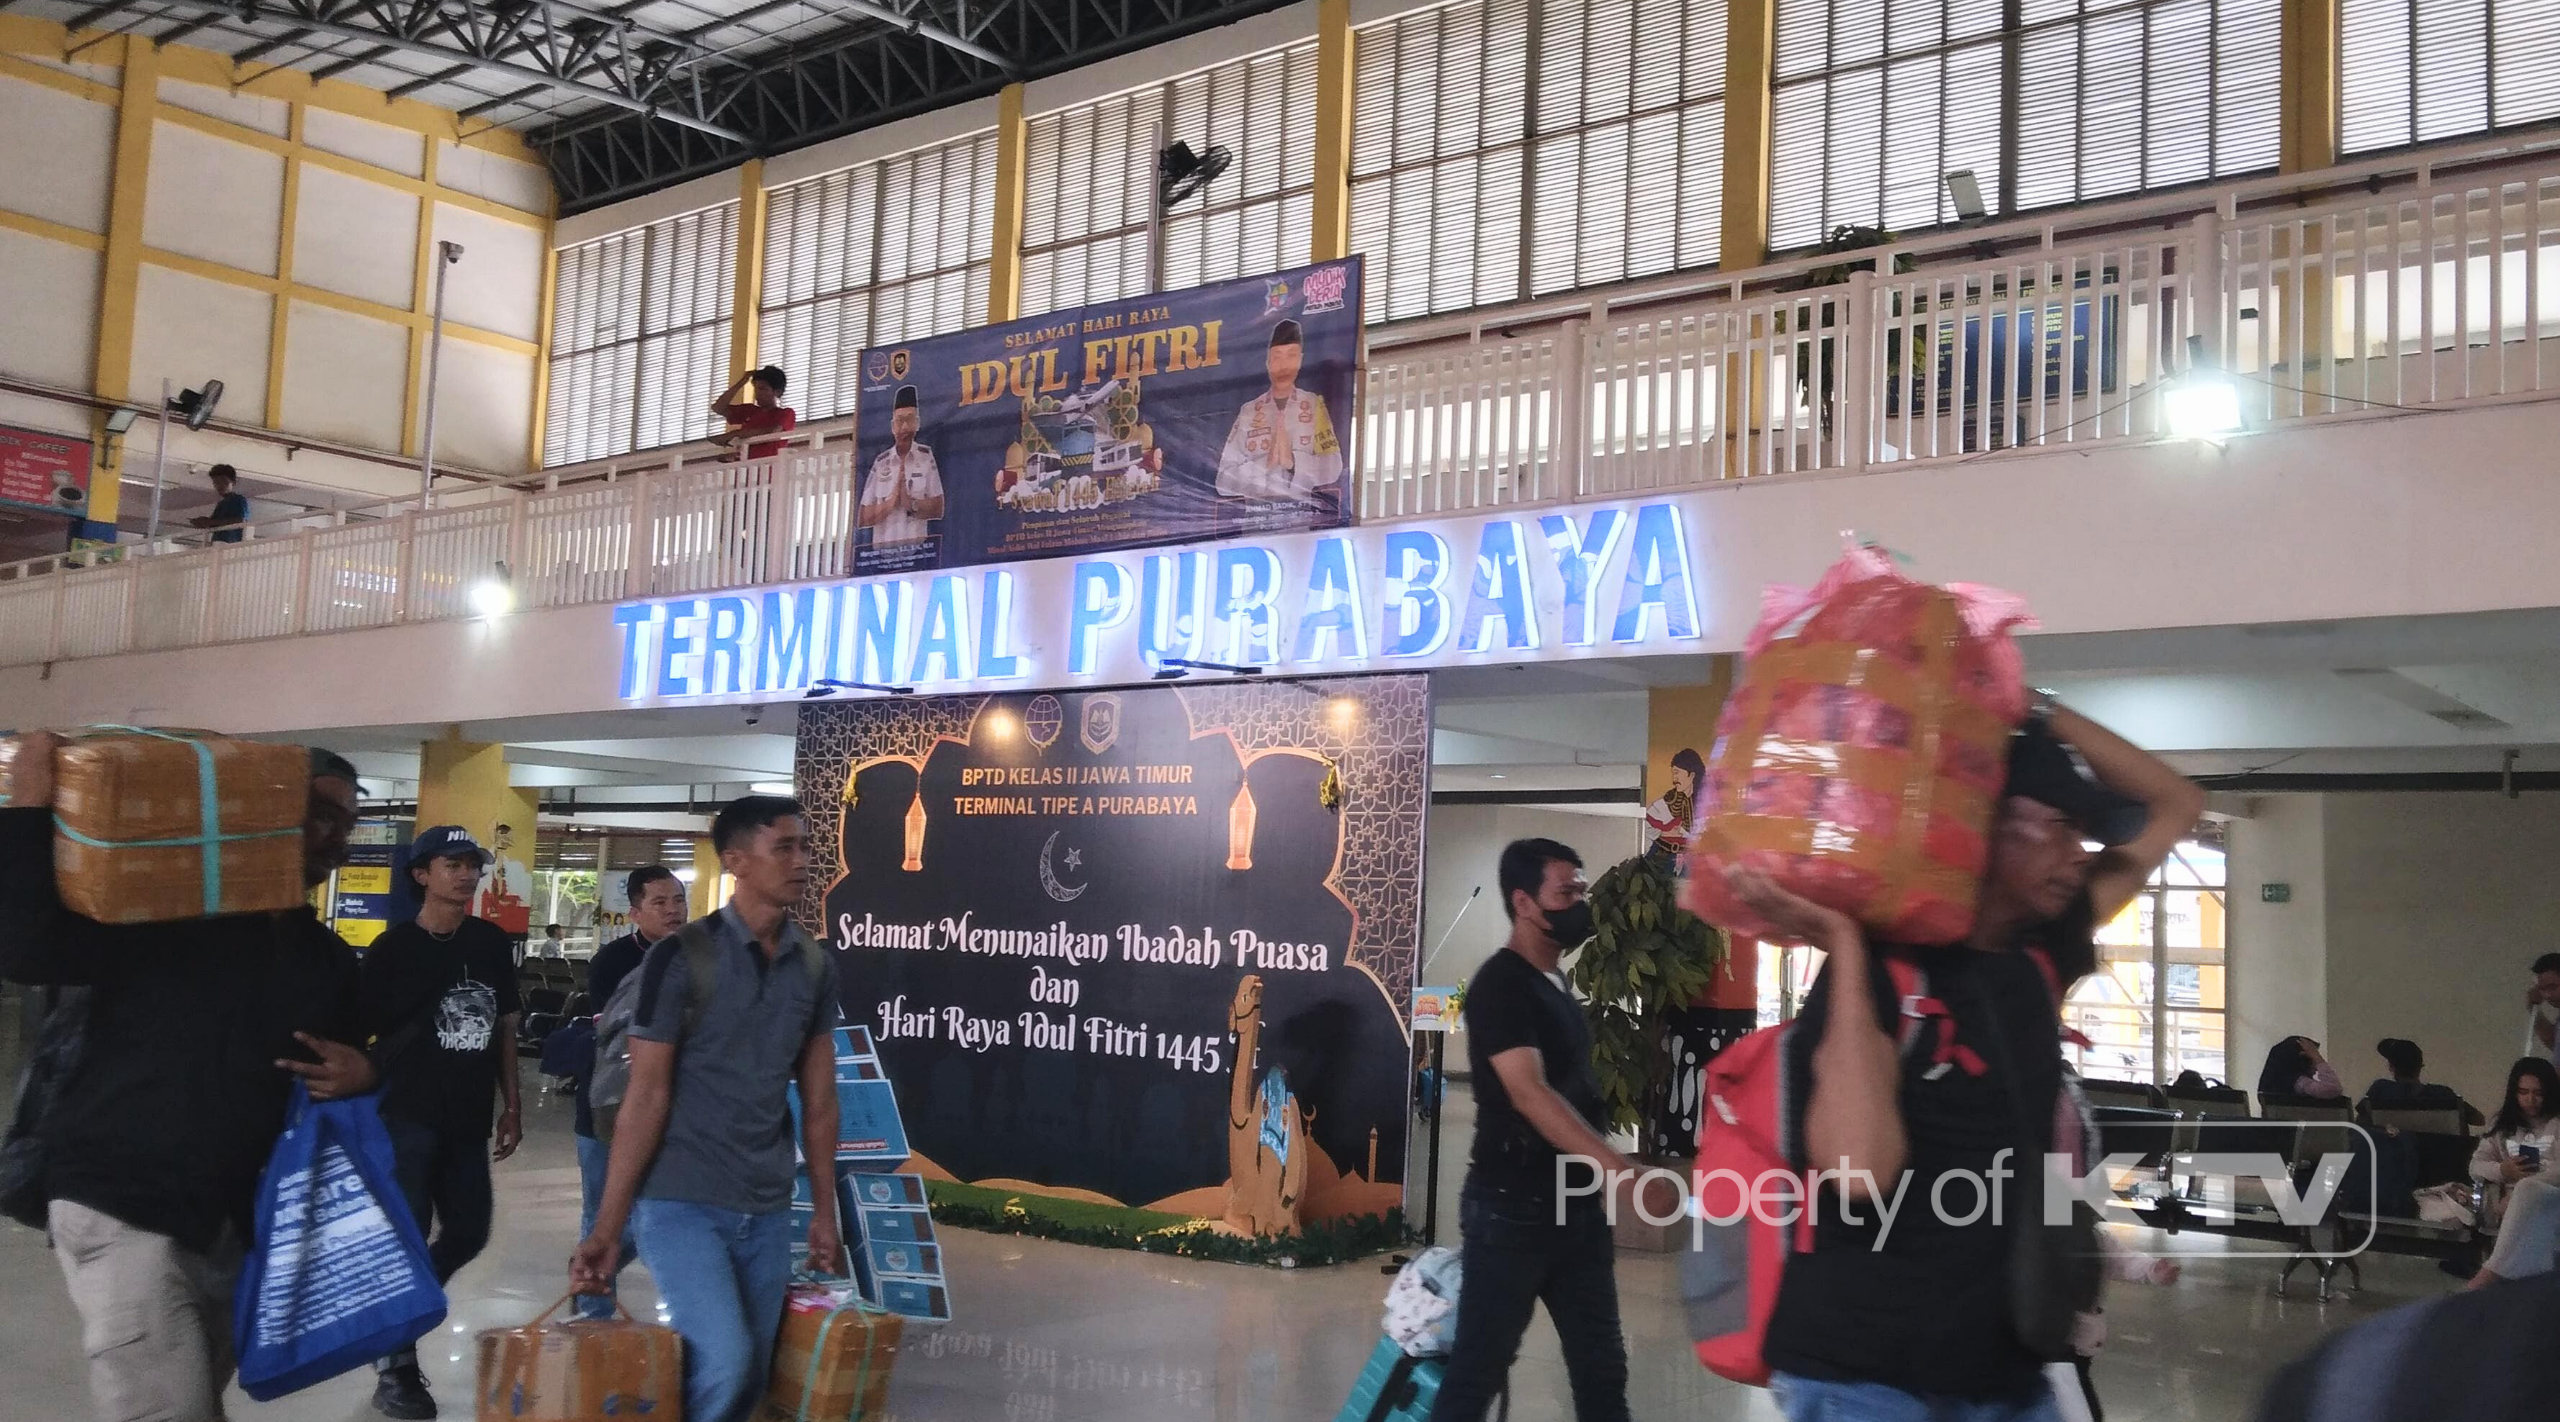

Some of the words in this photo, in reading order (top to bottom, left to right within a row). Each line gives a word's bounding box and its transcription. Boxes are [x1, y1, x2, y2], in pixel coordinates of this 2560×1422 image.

[1005, 322, 1077, 348] SELAMAT
[1082, 314, 1122, 333] HARI
[1129, 306, 1172, 326] RAYA
[957, 348, 1069, 408] IDUL
[1081, 319, 1223, 386] FITRI
[612, 570, 1031, 699] TERMINAL
[1066, 502, 1703, 675] PURABAYA
[962, 767, 1005, 786] BPTD
[1008, 767, 1063, 786] KELAS
[1067, 766, 1077, 784] II
[1081, 765, 1130, 784] JAWA
[1135, 764, 1194, 784] TIMUR
[954, 796, 1037, 815] TERMINAL
[1041, 796, 1079, 815] TIPE
[1082, 796, 1094, 815] A
[1098, 796, 1198, 815] PURABAYA
[836, 912, 935, 951] Selamat
[936, 910, 1109, 967] Menunaikan
[1116, 923, 1222, 970] Ibadah
[1229, 929, 1329, 972] Puasa
[1029, 965, 1080, 1008] dan
[875, 994, 936, 1042] Hari
[942, 1006, 1011, 1053] Raya
[1017, 1011, 1077, 1053] Idul
[1083, 1016, 1148, 1059] Fitri
[1156, 1032, 1221, 1074] 1445
